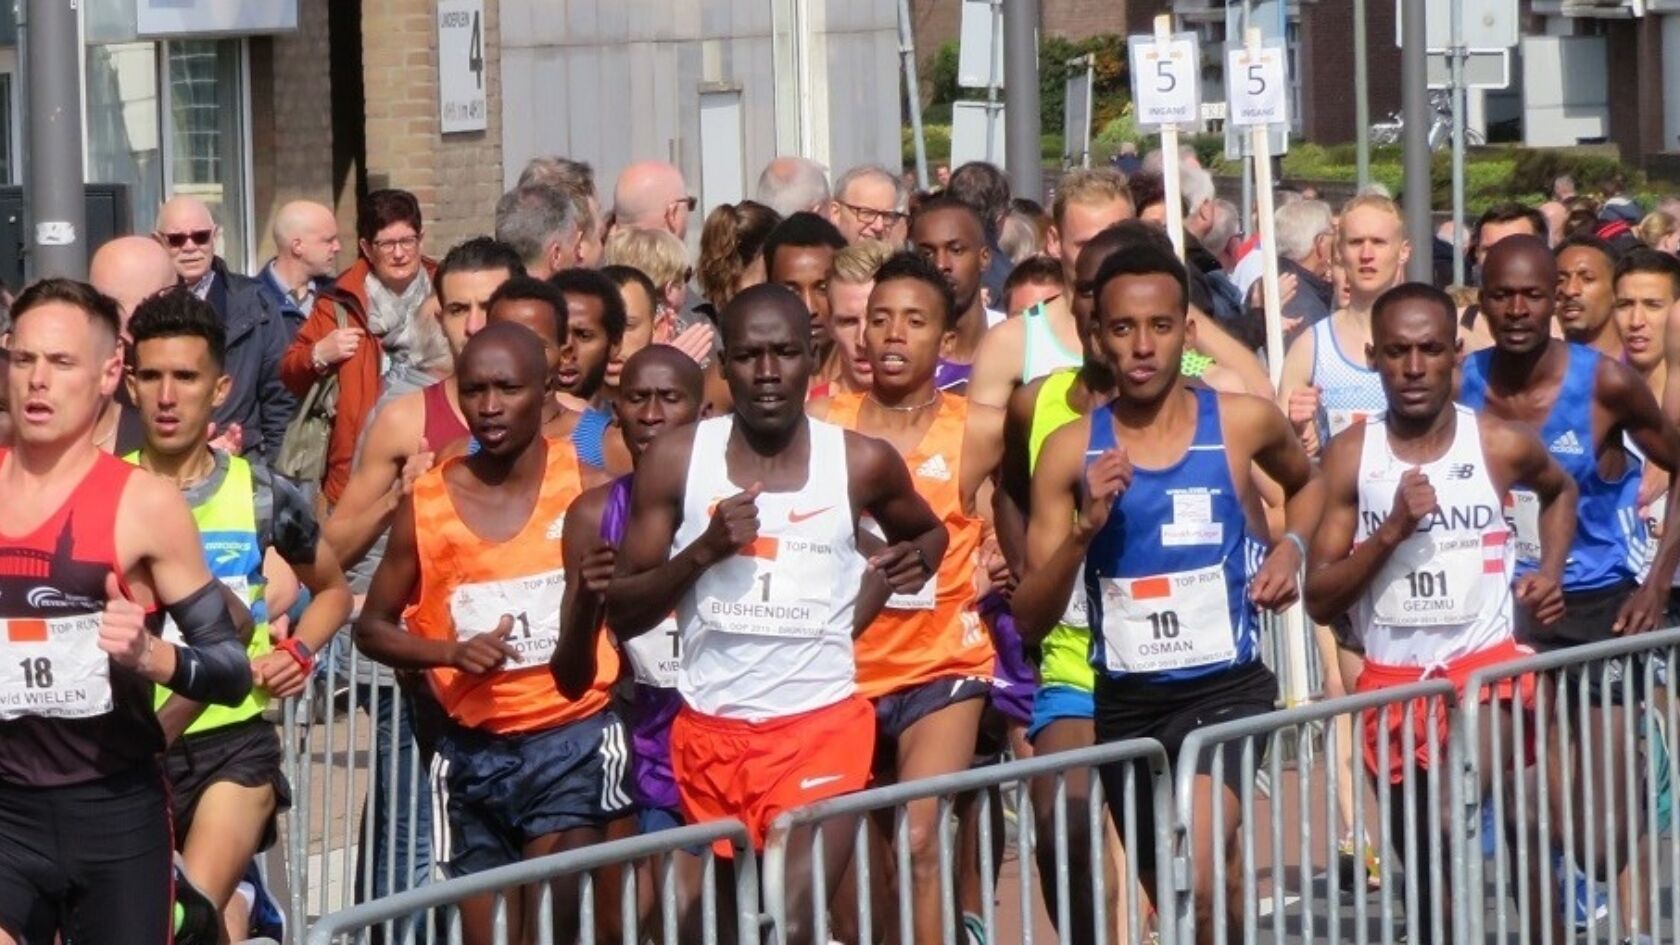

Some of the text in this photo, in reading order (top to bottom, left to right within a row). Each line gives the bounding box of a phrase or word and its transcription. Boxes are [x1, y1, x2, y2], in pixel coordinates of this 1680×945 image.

[469, 10, 483, 90] 4
[1156, 60, 1177, 93] 5
[1247, 65, 1266, 95] 5
[786, 541, 832, 555] TOP RUN
[523, 578, 544, 591] TOP
[758, 572, 772, 602] 1
[1175, 571, 1221, 588] TOP RUN
[1405, 571, 1448, 598] 101
[711, 601, 810, 620] BUSHENDICH
[1403, 600, 1454, 612] GEZIMU
[51, 617, 99, 635] TOP RUN
[1146, 610, 1180, 640] 10
[1138, 641, 1193, 657] OSMAN
[19, 657, 53, 688] 18
[657, 661, 680, 672] KIB
[24, 688, 86, 704] WIELEN
